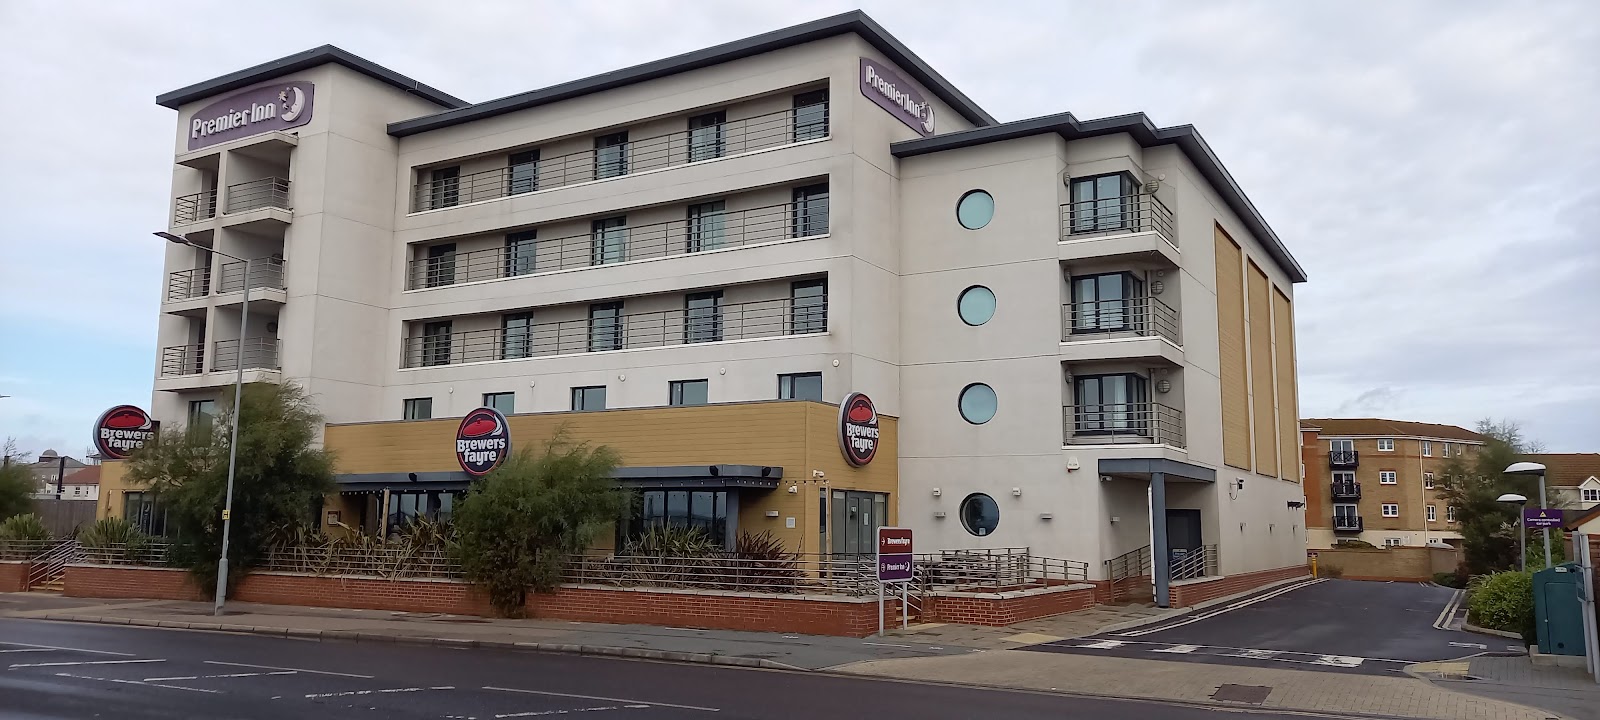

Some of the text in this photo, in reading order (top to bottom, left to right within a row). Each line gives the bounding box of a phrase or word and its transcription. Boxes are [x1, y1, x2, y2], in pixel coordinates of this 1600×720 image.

[865, 65, 920, 118] Premier Inn
[191, 103, 277, 139] Premier Inn
[100, 428, 154, 440] Brewers
[846, 422, 879, 438] Brewers
[108, 436, 144, 451] fayre
[457, 438, 505, 452] Brewers
[851, 433, 873, 453] fayre
[464, 448, 496, 466] fayre
